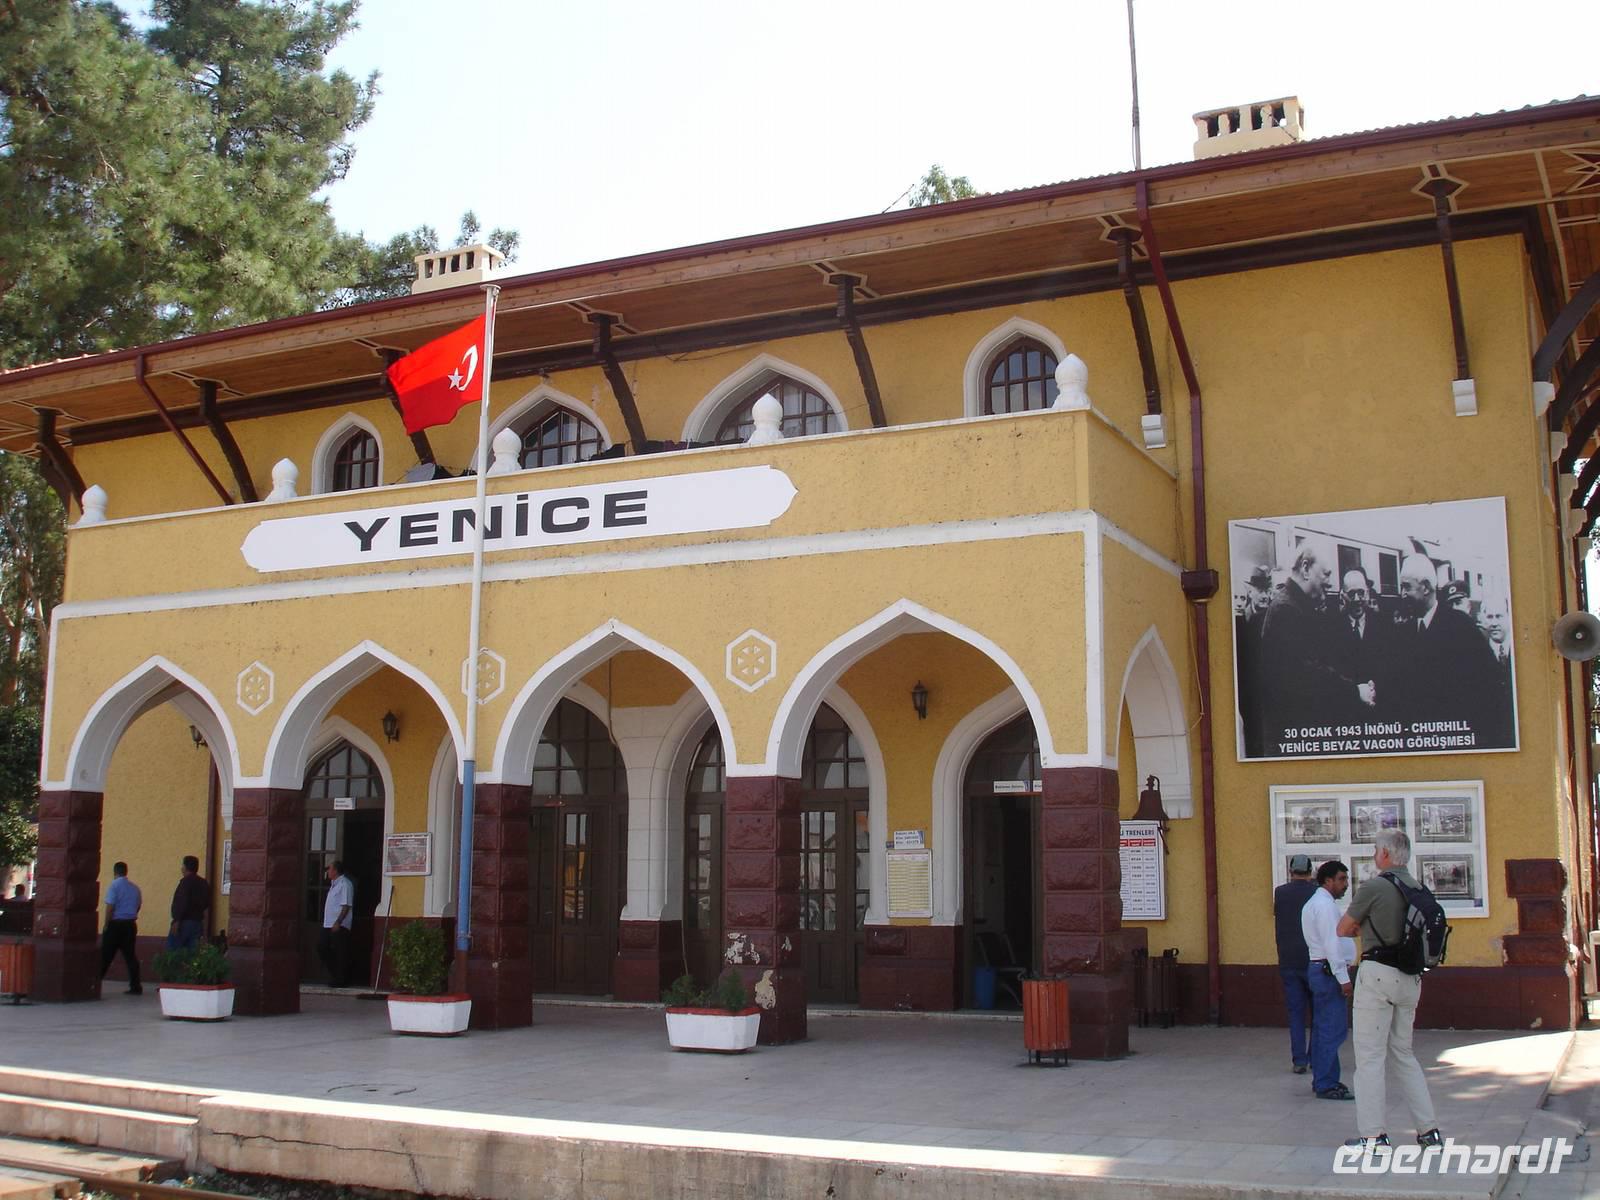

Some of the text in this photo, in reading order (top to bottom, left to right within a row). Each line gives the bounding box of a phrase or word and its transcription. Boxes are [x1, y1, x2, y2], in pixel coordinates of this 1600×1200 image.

[344, 489, 649, 552] YENİCE
[1284, 727, 1299, 739] 30
[1300, 725, 1333, 738] OCAK
[1335, 724, 1361, 737] 1943
[1364, 720, 1401, 735] İNÖNÜ
[1411, 721, 1471, 733] CHURHILL
[1279, 732, 1475, 753] YENİCE BEYAZ VAGON GÖRÜŞMESİ
